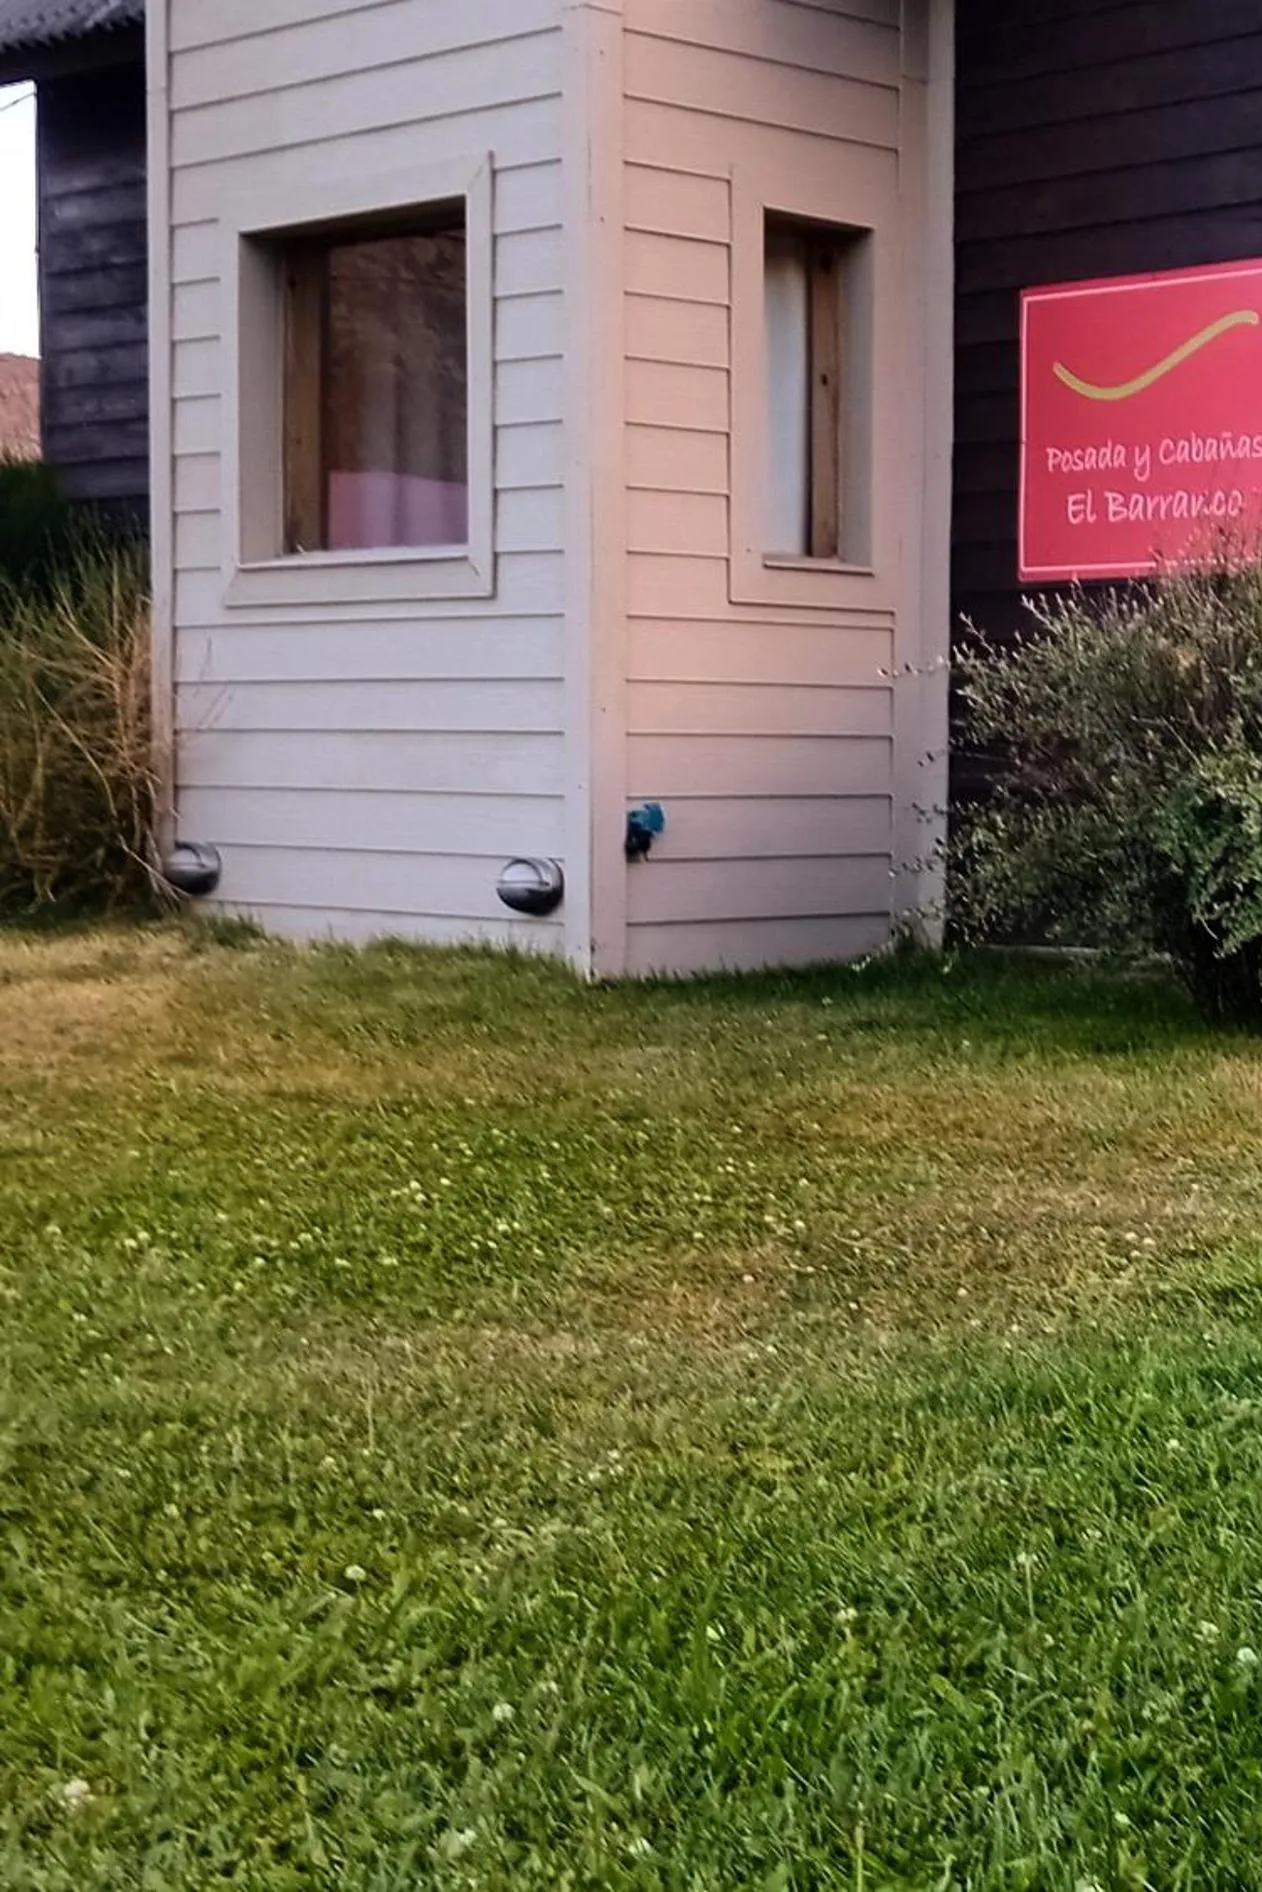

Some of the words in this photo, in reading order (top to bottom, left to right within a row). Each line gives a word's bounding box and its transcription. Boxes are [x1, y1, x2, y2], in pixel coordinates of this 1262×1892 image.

[1045, 438, 1126, 473] Posada
[1133, 444, 1151, 482] y
[1067, 488, 1097, 525] El
